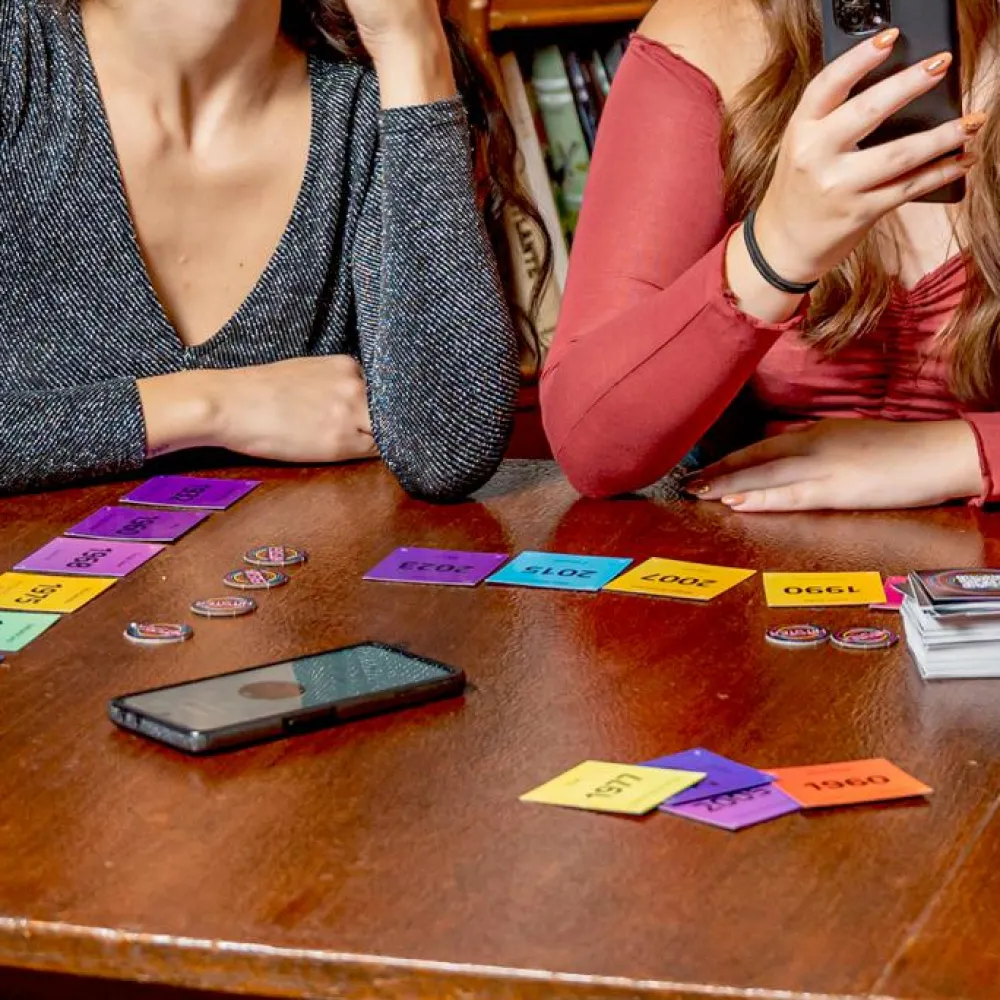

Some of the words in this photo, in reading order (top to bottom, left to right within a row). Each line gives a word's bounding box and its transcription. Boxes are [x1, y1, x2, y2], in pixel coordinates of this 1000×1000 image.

[398, 561, 474, 574] 2023
[522, 565, 598, 579] 2015
[641, 573, 718, 588] 2007
[783, 585, 860, 595] 1990
[804, 774, 890, 791] 1960
